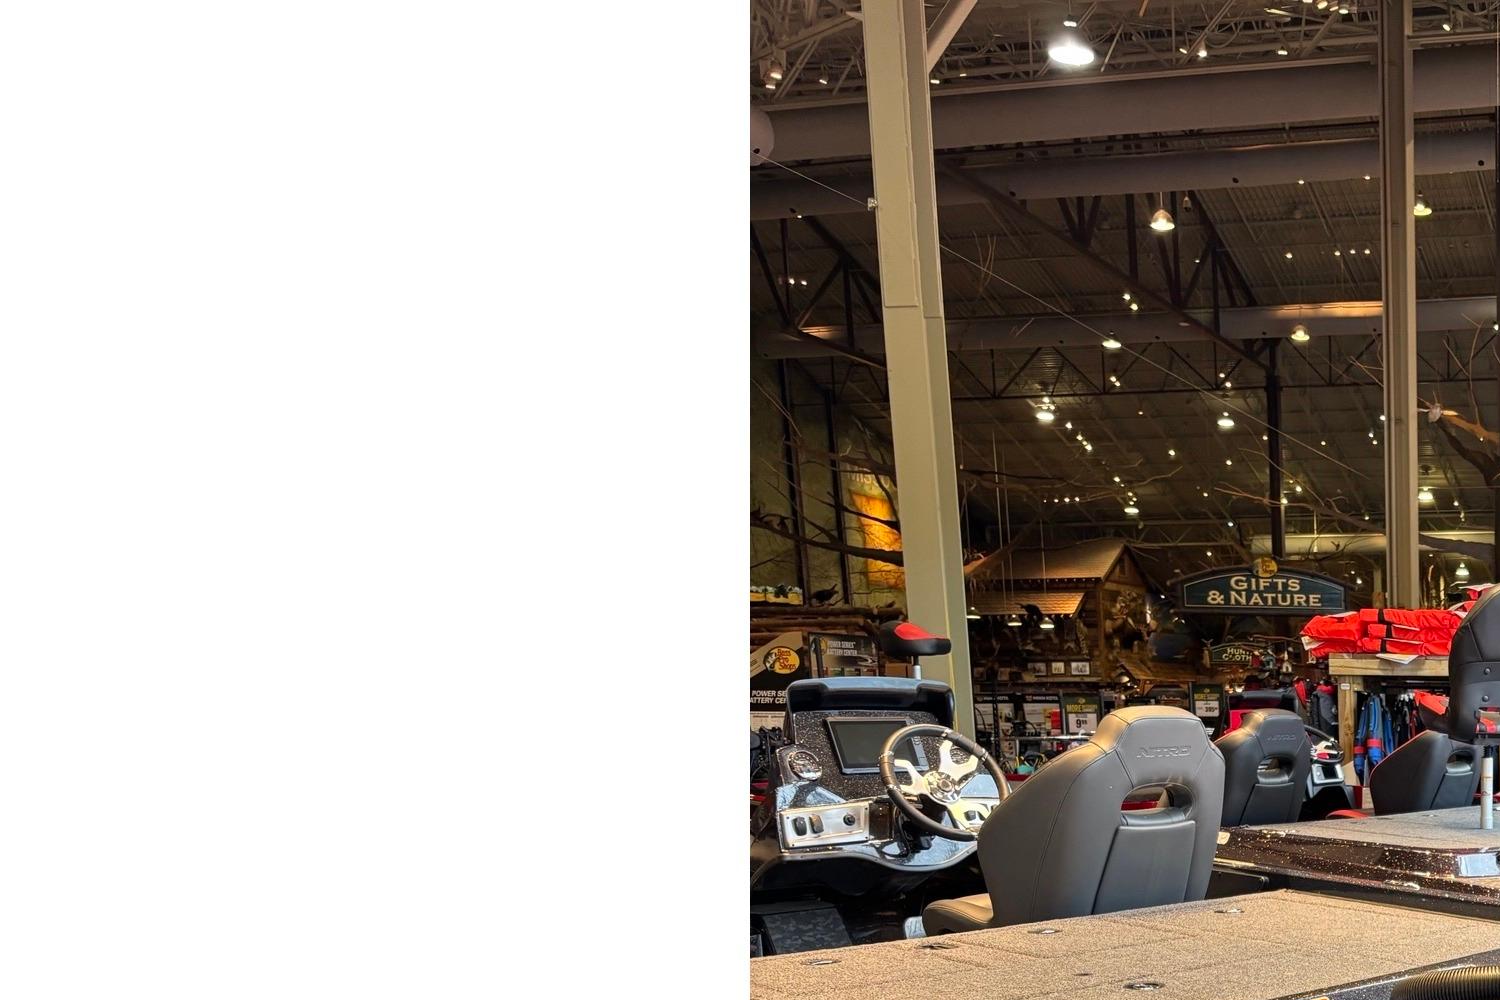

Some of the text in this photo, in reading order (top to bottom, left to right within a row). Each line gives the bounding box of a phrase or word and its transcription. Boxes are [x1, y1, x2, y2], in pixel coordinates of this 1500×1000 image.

[1230, 576, 1300, 591] GIFTS
[1207, 590, 1322, 607] & NATURE
[1136, 745, 1192, 758] NITRO
